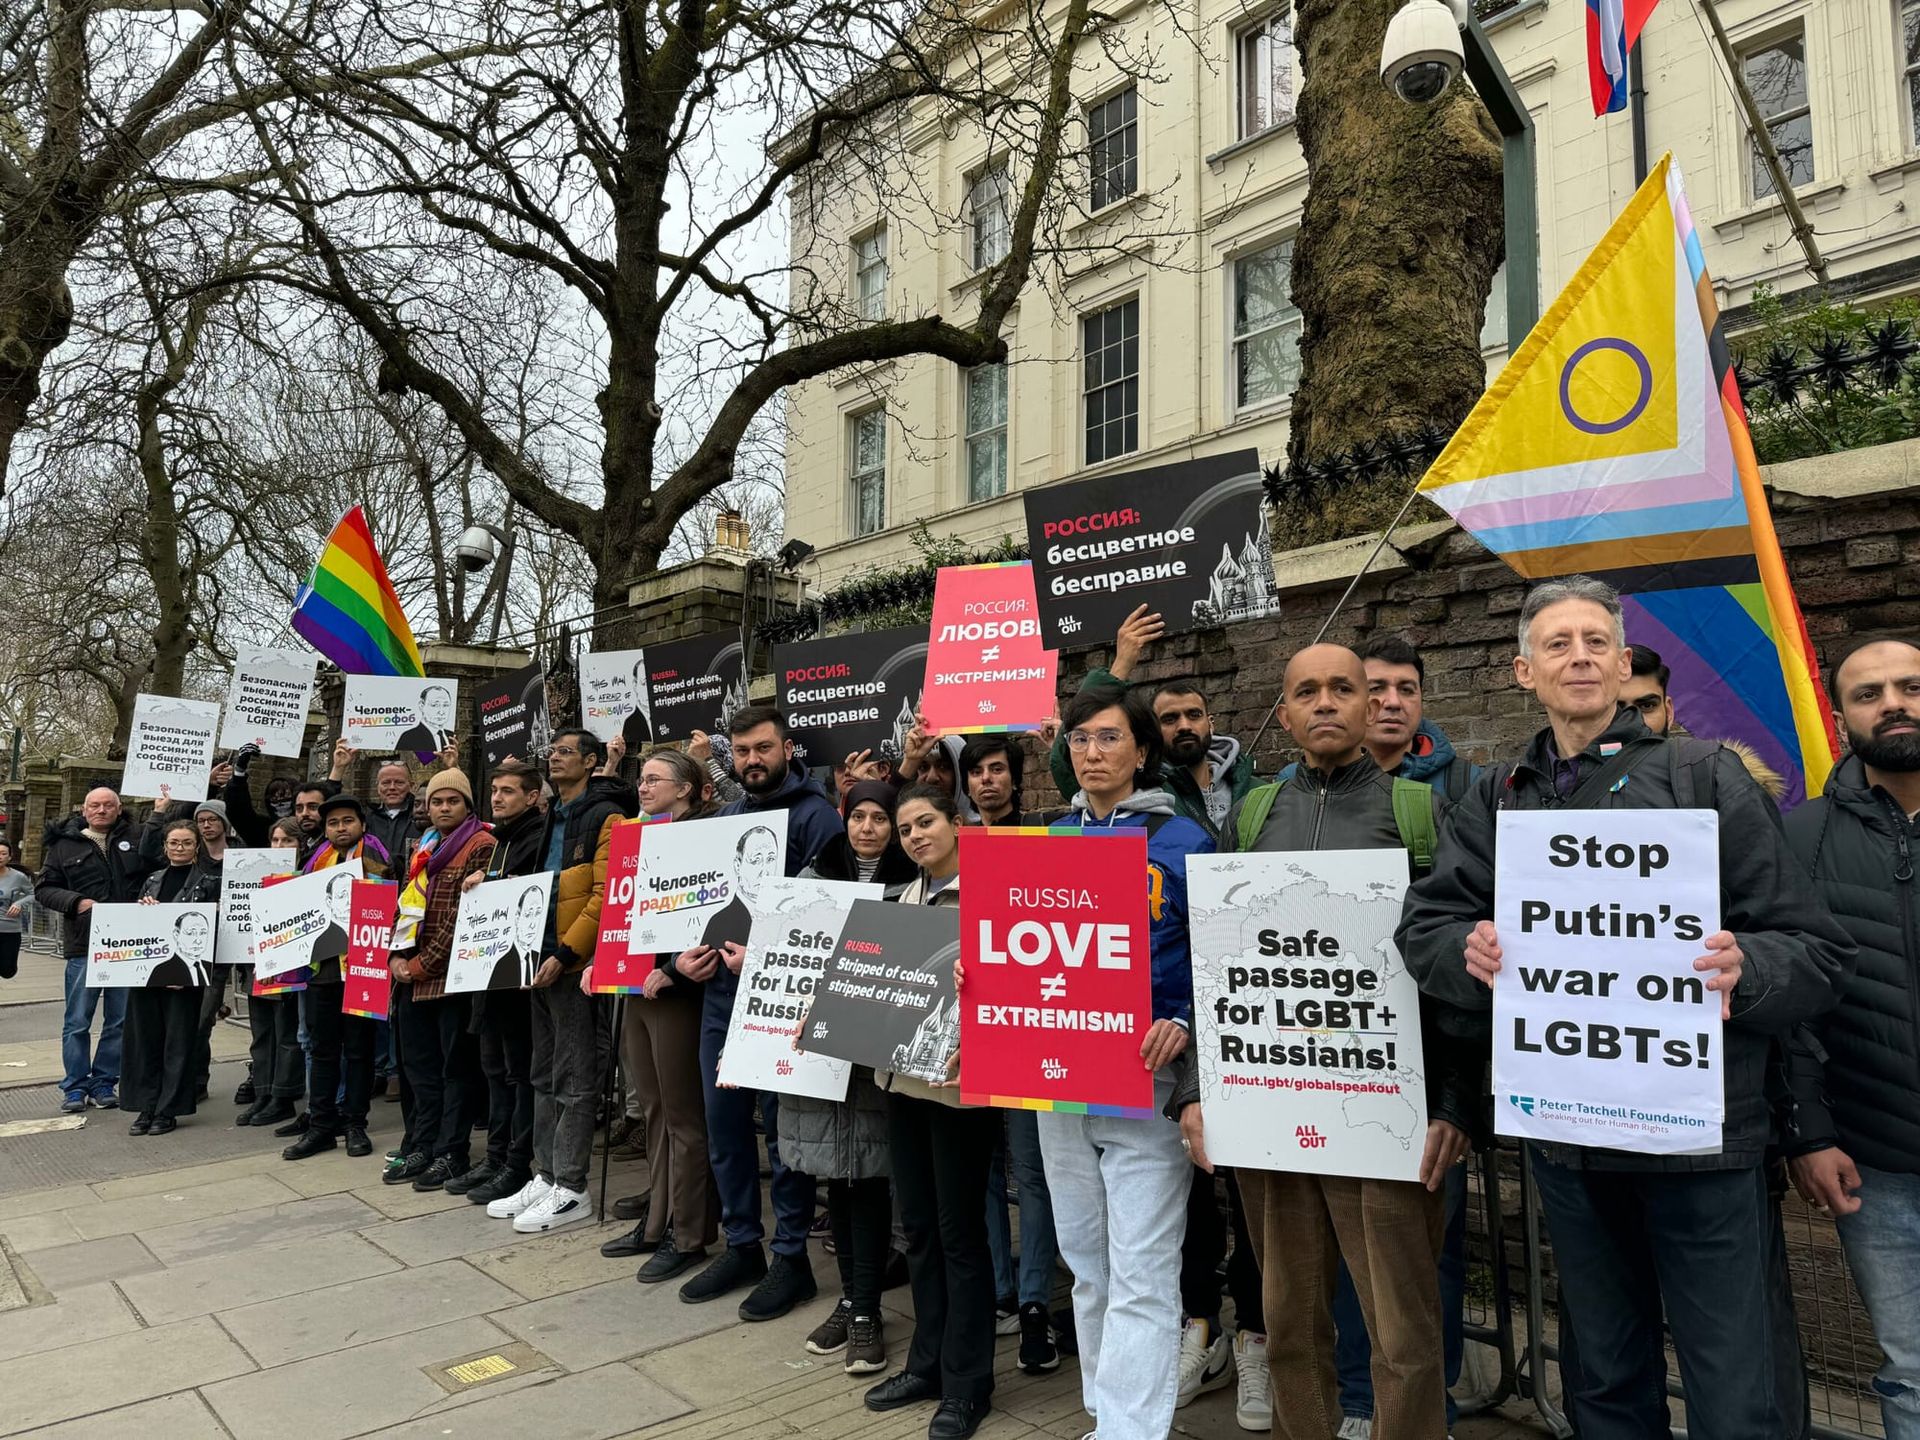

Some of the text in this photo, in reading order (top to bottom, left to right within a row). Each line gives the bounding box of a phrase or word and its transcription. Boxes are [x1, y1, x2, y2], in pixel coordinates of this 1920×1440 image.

[1044, 508, 1141, 540] РОССИЯ:
[1047, 527, 1195, 565] бесцветное
[1050, 560, 1186, 596] бесправие
[965, 599, 1029, 615] РОССИЯ:
[1058, 615, 1076, 628] ALL
[1062, 622, 1082, 634] OUT
[240, 673, 307, 691] Безопасный
[652, 669, 677, 680] RUSSIA:
[786, 664, 850, 683] РОССИЯ:
[934, 668, 1045, 685] ЭКСТРЕМИЗМ!
[243, 686, 300, 700] выезд для
[653, 674, 722, 693] Stripped of colors,
[787, 681, 886, 703] бесцветное
[240, 696, 284, 708] россиян
[655, 686, 722, 707] stripped of rights!
[235, 705, 300, 719] сообщества
[355, 706, 411, 715] Человек-
[483, 703, 526, 726] бесцветное
[789, 707, 879, 728] бесправие
[140, 722, 210, 738] Безопасный
[247, 715, 285, 727] LGBT+!
[348, 714, 416, 727] радугофоб
[143, 734, 204, 746] выезд для
[485, 722, 524, 742] бесправие
[141, 744, 188, 754] россиян
[794, 749, 808, 758] OUT
[137, 753, 205, 765] сообщества
[150, 762, 190, 774] LGBT+!
[1549, 834, 1670, 878] Stop
[228, 880, 264, 889] Безопа
[608, 876, 634, 905] LO
[650, 870, 724, 893] Человек-
[639, 881, 729, 916] радугофоб
[1009, 887, 1099, 910] RUSSIA:
[263, 908, 320, 935] Человек-
[362, 909, 384, 920] RUSSIA:
[1521, 900, 1703, 941] Putin’s
[101, 937, 165, 948] Человек-
[259, 914, 326, 953] радугофоб
[353, 924, 390, 950] LOVE
[460, 934, 469, 943] IS
[473, 928, 499, 940] AFRAID
[602, 930, 630, 943] EXTRE
[788, 929, 833, 950] Safe
[1258, 929, 1340, 957] Safe
[94, 944, 170, 963] радугофоб
[457, 940, 509, 961] RAINBOWS
[845, 940, 882, 954] RUSSIA:
[979, 920, 1131, 970] LOVE
[764, 952, 832, 970] passa
[350, 965, 388, 980] EXTREMISM!
[751, 972, 781, 992] for
[837, 957, 938, 988] Stripped of colors,
[1228, 967, 1377, 996] passage
[828, 980, 876, 998] stripped
[876, 988, 890, 1000] of
[890, 989, 930, 1008] rights!
[1518, 967, 1703, 1004] war on
[747, 997, 807, 1021] Russi
[1214, 997, 1396, 1029] for LGBT+
[814, 1021, 827, 1030] ALL
[977, 1004, 1134, 1034] EXTREMISM!
[813, 1030, 829, 1039] OUT
[1514, 1018, 1710, 1070] LGBTs!
[1221, 1035, 1396, 1070] Russians!
[777, 1067, 793, 1075] OUT
[1041, 1058, 1061, 1069] ALL
[1045, 1068, 1068, 1079] OUT
[1223, 1074, 1400, 1094] allout.lgbt/globalspeakout
[1540, 1098, 1706, 1127] Peter Tatchell Foundation
[1295, 1125, 1318, 1137] ALL
[1540, 1111, 1669, 1135] Speaking out for Human Rights
[1300, 1137, 1327, 1149] OUT
